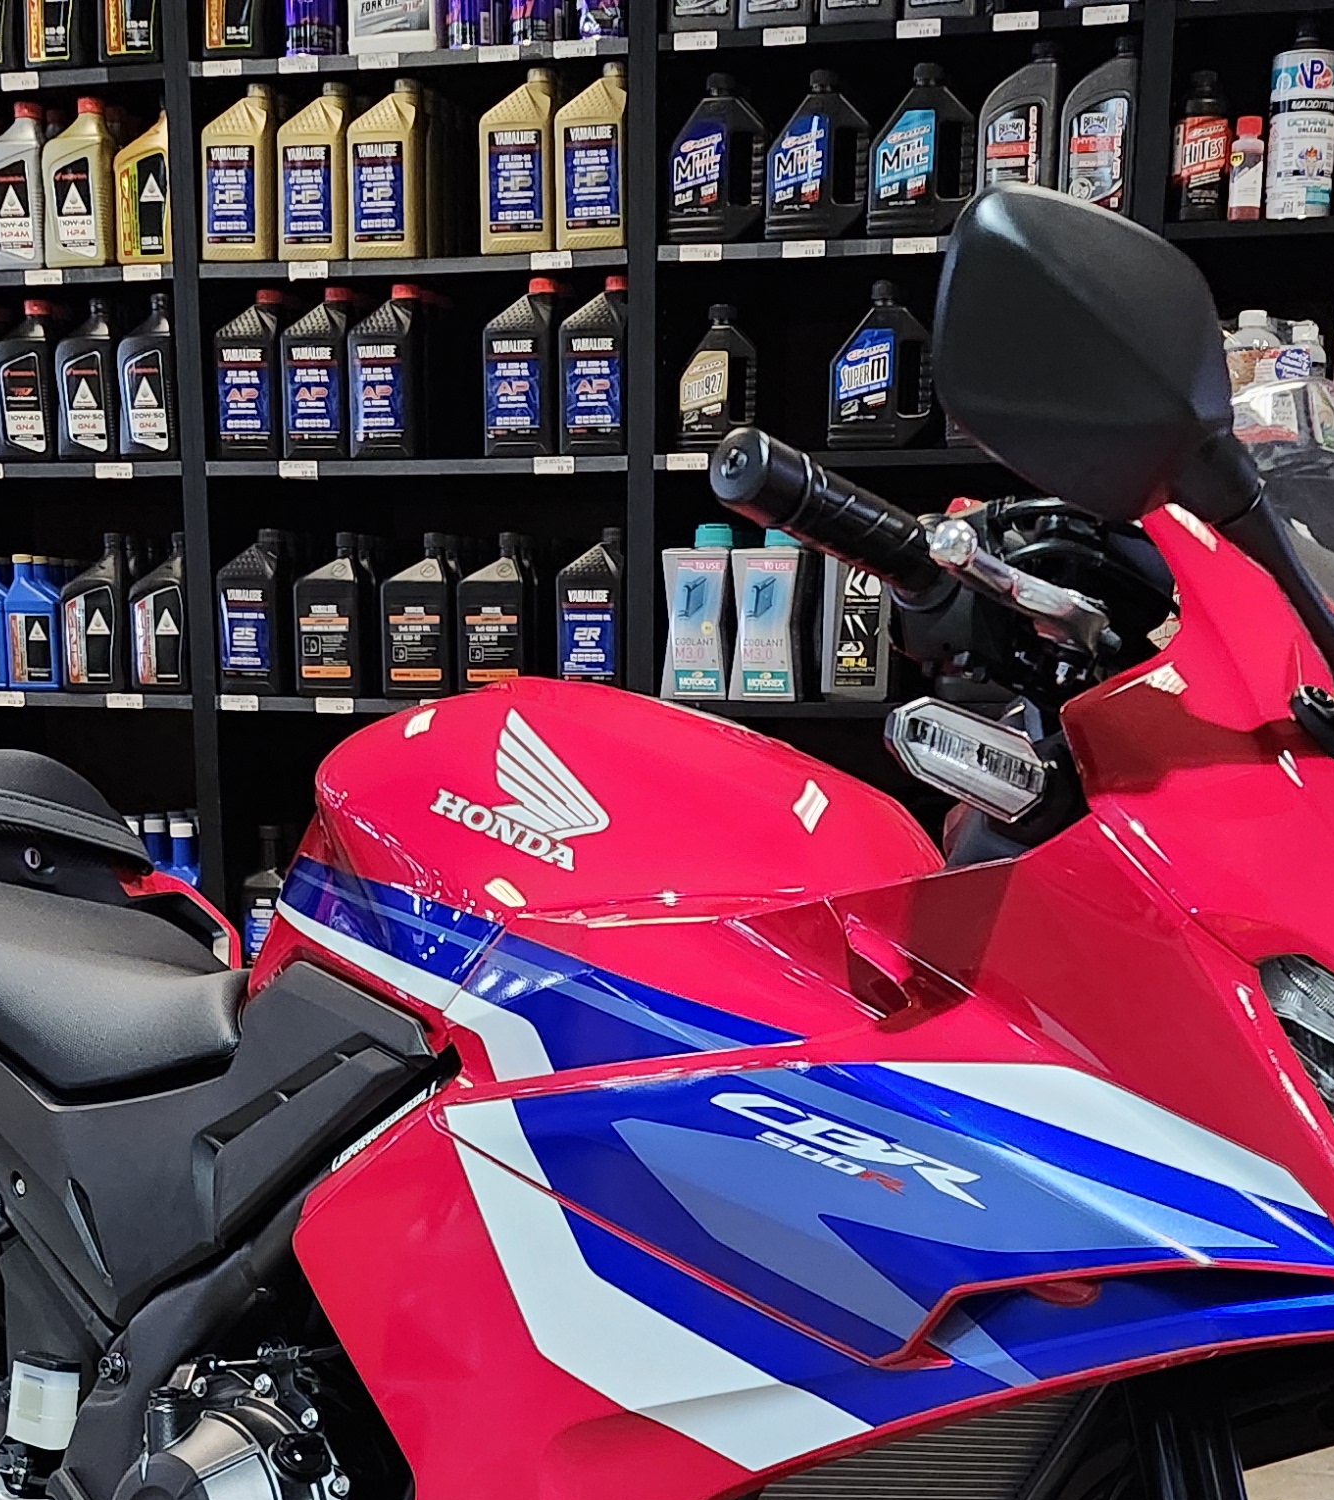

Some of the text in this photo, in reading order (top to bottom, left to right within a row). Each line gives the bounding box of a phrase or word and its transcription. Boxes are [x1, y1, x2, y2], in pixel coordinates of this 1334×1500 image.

[1299, 59, 1325, 89] VP
[494, 131, 538, 146] YAMALUBE
[570, 125, 612, 142] YAMALUBE
[211, 147, 250, 161] YAMALUBE
[287, 147, 326, 161] YAMALUBE
[357, 143, 397, 158] YAMALUBE
[0, 230, 30, 239] HP4M
[66, 228, 87, 237] HP4
[704, 372, 723, 394] 927
[841, 364, 870, 391] SUPER
[226, 387, 259, 402] AP
[296, 386, 329, 401] AP
[362, 385, 393, 400] AP
[496, 380, 530, 396] AP
[695, 561, 721, 570] TO USE
[764, 561, 791, 570] TO USE
[675, 637, 714, 646] COOLANT
[743, 638, 783, 647] COOLANT
[675, 647, 705, 660] M3.0
[743, 648, 773, 660] M3.0
[679, 677, 717, 687] MOTOREX
[746, 678, 785, 688] MOTOREX
[429, 787, 576, 872] HONDA
[710, 1093, 986, 1209] CBR
[756, 1130, 906, 1194] 500R
